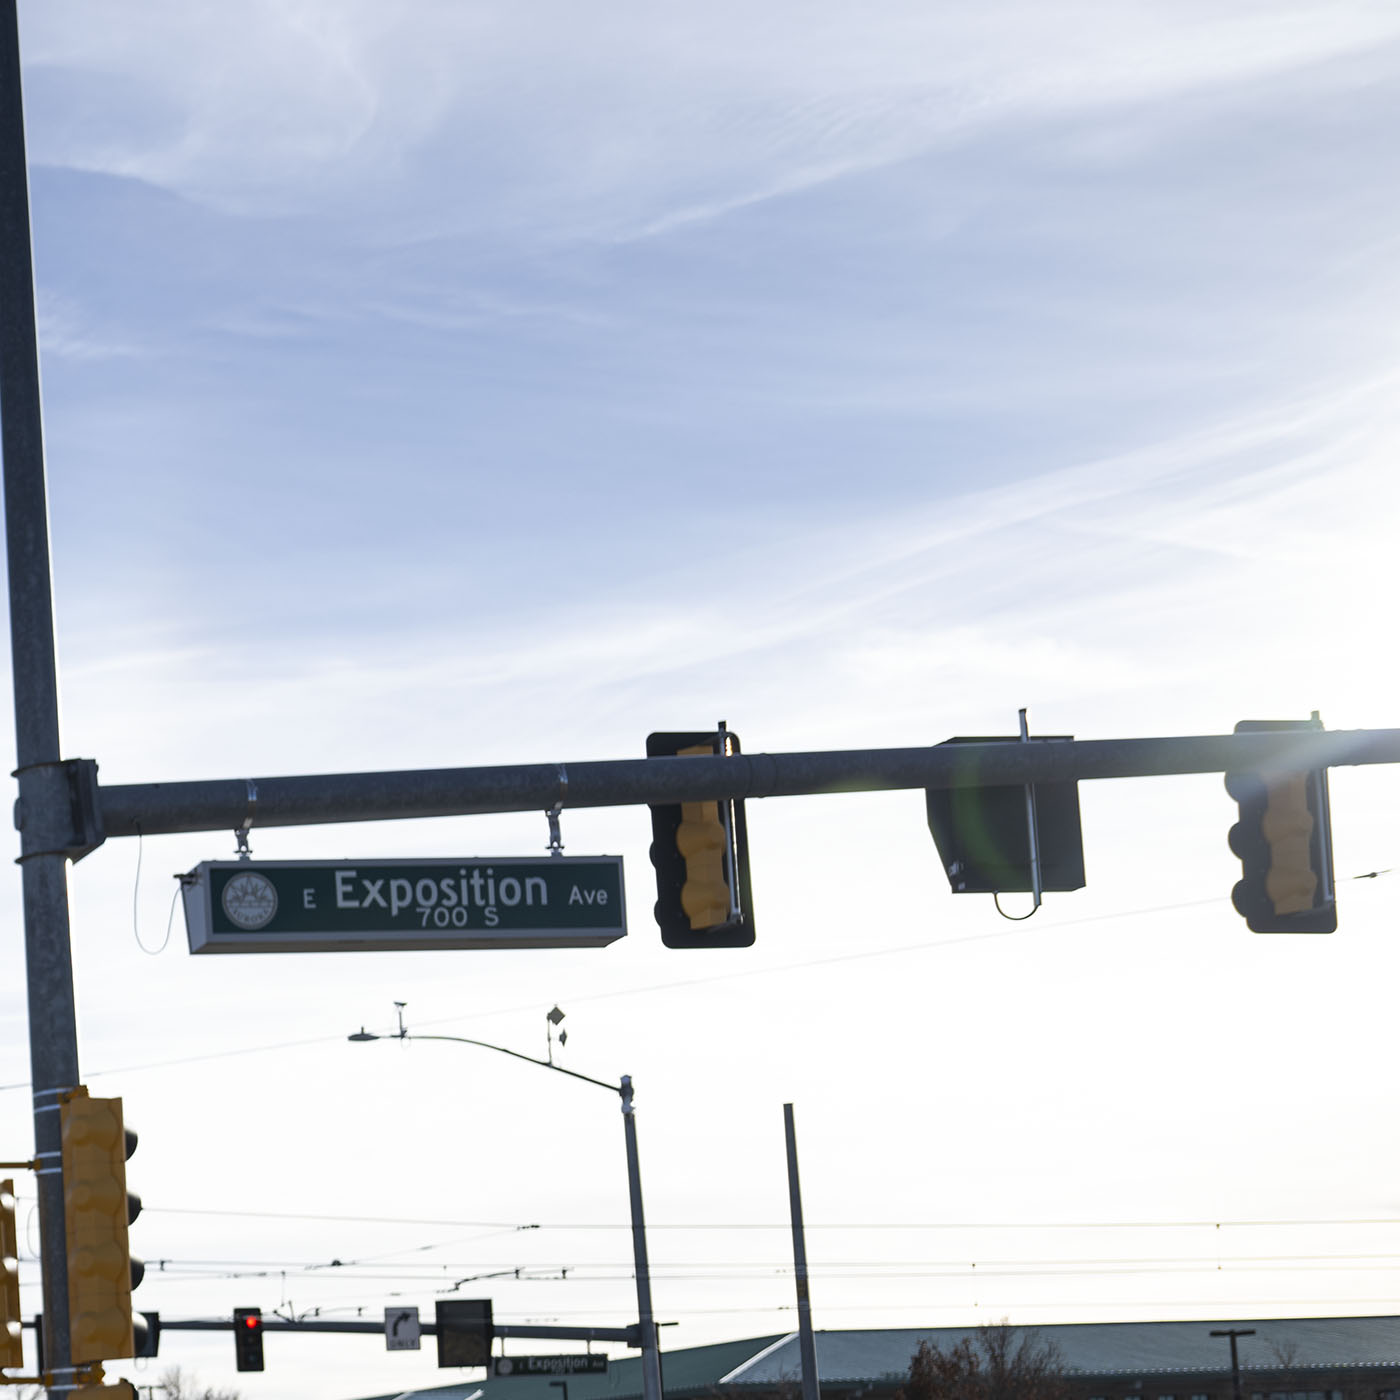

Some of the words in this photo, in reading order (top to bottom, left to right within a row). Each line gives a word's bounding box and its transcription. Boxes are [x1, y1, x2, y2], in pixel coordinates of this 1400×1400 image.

[303, 888, 317, 909] E
[335, 868, 548, 917] Exposition
[568, 885, 608, 905] Ave
[416, 907, 467, 927] 700
[485, 907, 499, 927] S
